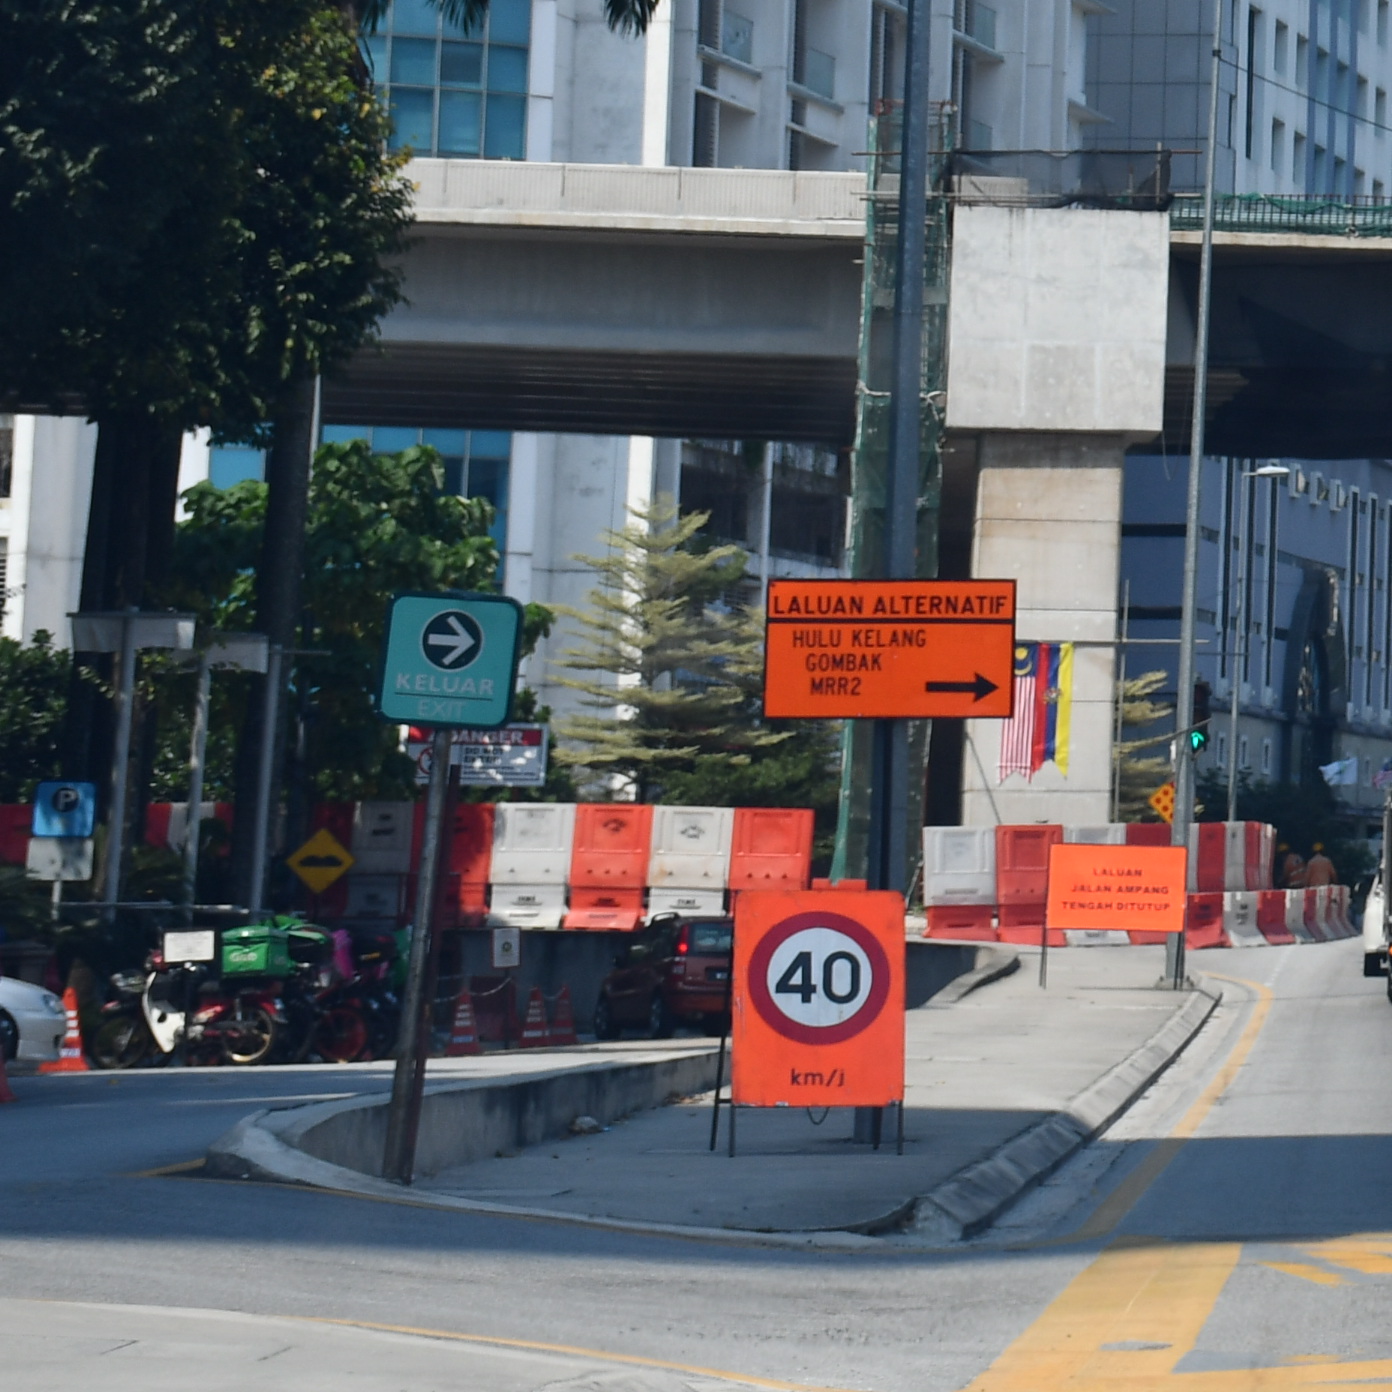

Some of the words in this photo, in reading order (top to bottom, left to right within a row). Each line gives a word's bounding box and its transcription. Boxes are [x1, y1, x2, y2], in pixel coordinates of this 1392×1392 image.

[773, 595, 864, 615] LALUAN
[872, 595, 1007, 615] ALTERNATIF
[792, 630, 841, 648] HULU
[851, 629, 926, 648] KELANG
[805, 653, 882, 672] GOMBAK
[396, 673, 494, 694] KELUAR
[810, 677, 862, 696] MRR2
[419, 699, 464, 718] EXIT
[1093, 868, 1143, 877] LALUAN
[1071, 884, 1112, 893] JALAN
[1116, 886, 1169, 895] AMPANG
[1062, 901, 1113, 910] TENGAH
[1116, 902, 1171, 911] DITUTUP
[775, 951, 861, 1004] 40
[790, 1068, 845, 1087] km/j
